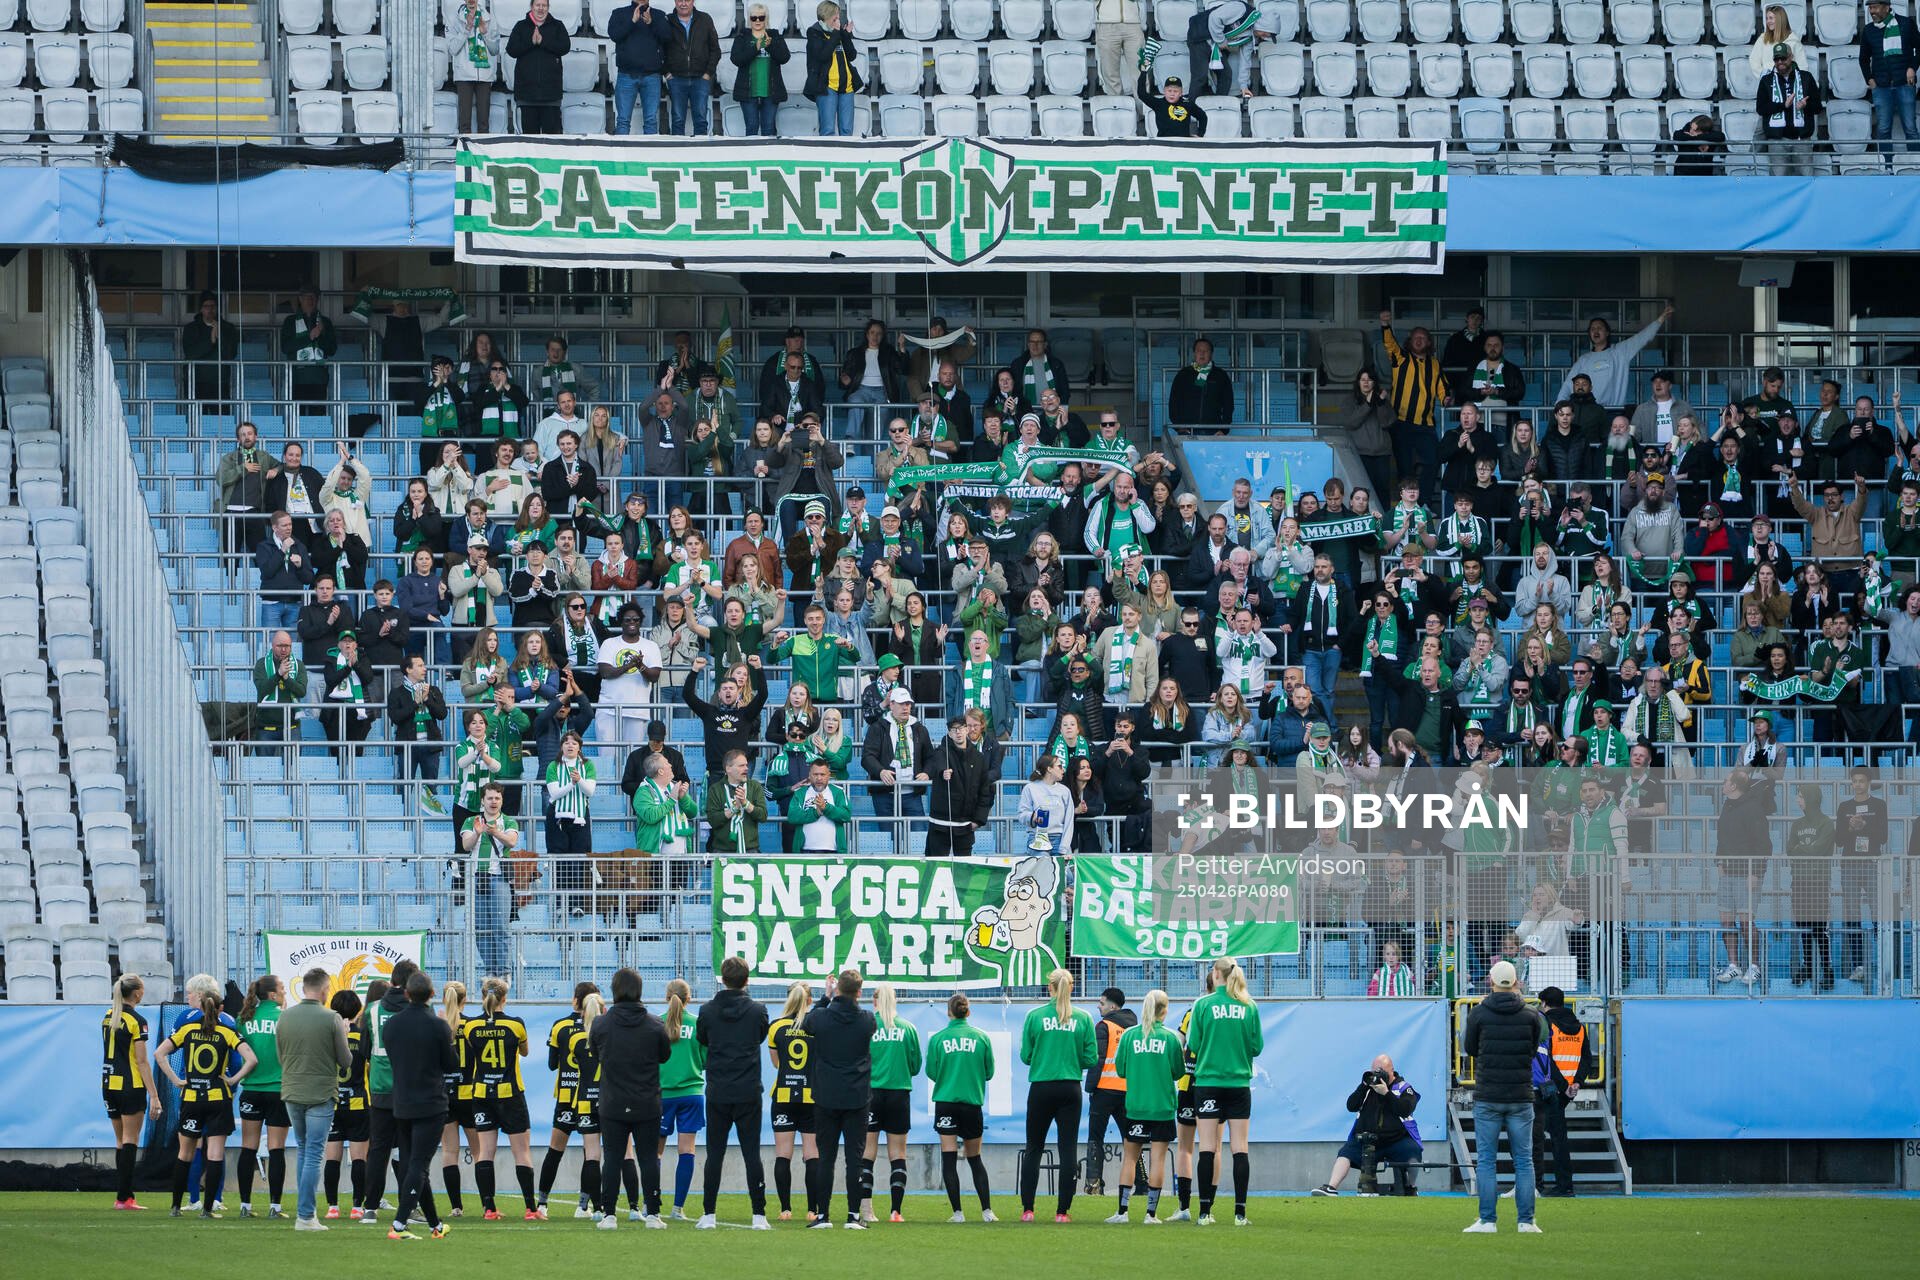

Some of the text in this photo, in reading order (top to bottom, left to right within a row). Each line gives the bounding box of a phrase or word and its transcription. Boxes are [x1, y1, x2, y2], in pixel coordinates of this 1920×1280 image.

[486, 164, 1414, 234] BAJENKOMPANIET
[897, 470, 916, 480] JUST
[1005, 485, 1063, 499] STOCKHOLM
[1299, 518, 1373, 540] AMMARBY
[722, 863, 966, 920] SNYGGA
[1080, 882, 1297, 931] BAJARNA
[289, 938, 405, 966] Going out in Styl
[722, 921, 965, 977] BAJARE
[1135, 929, 1229, 958] 2009
[1212, 1004, 1246, 1020] BAJEN
[245, 1019, 278, 1035] BAJEN
[476, 1029, 506, 1038] BLAKSTAD
[1043, 1016, 1077, 1033] BAJEN
[872, 1027, 906, 1042] BAJEN
[481, 1039, 506, 1069] 41
[788, 1038, 808, 1071] 9
[943, 1037, 977, 1054] BAJEN
[1133, 1038, 1166, 1054] BAJEN
[188, 1042, 218, 1074] 10
[1104, 1145, 1122, 1162] 84
